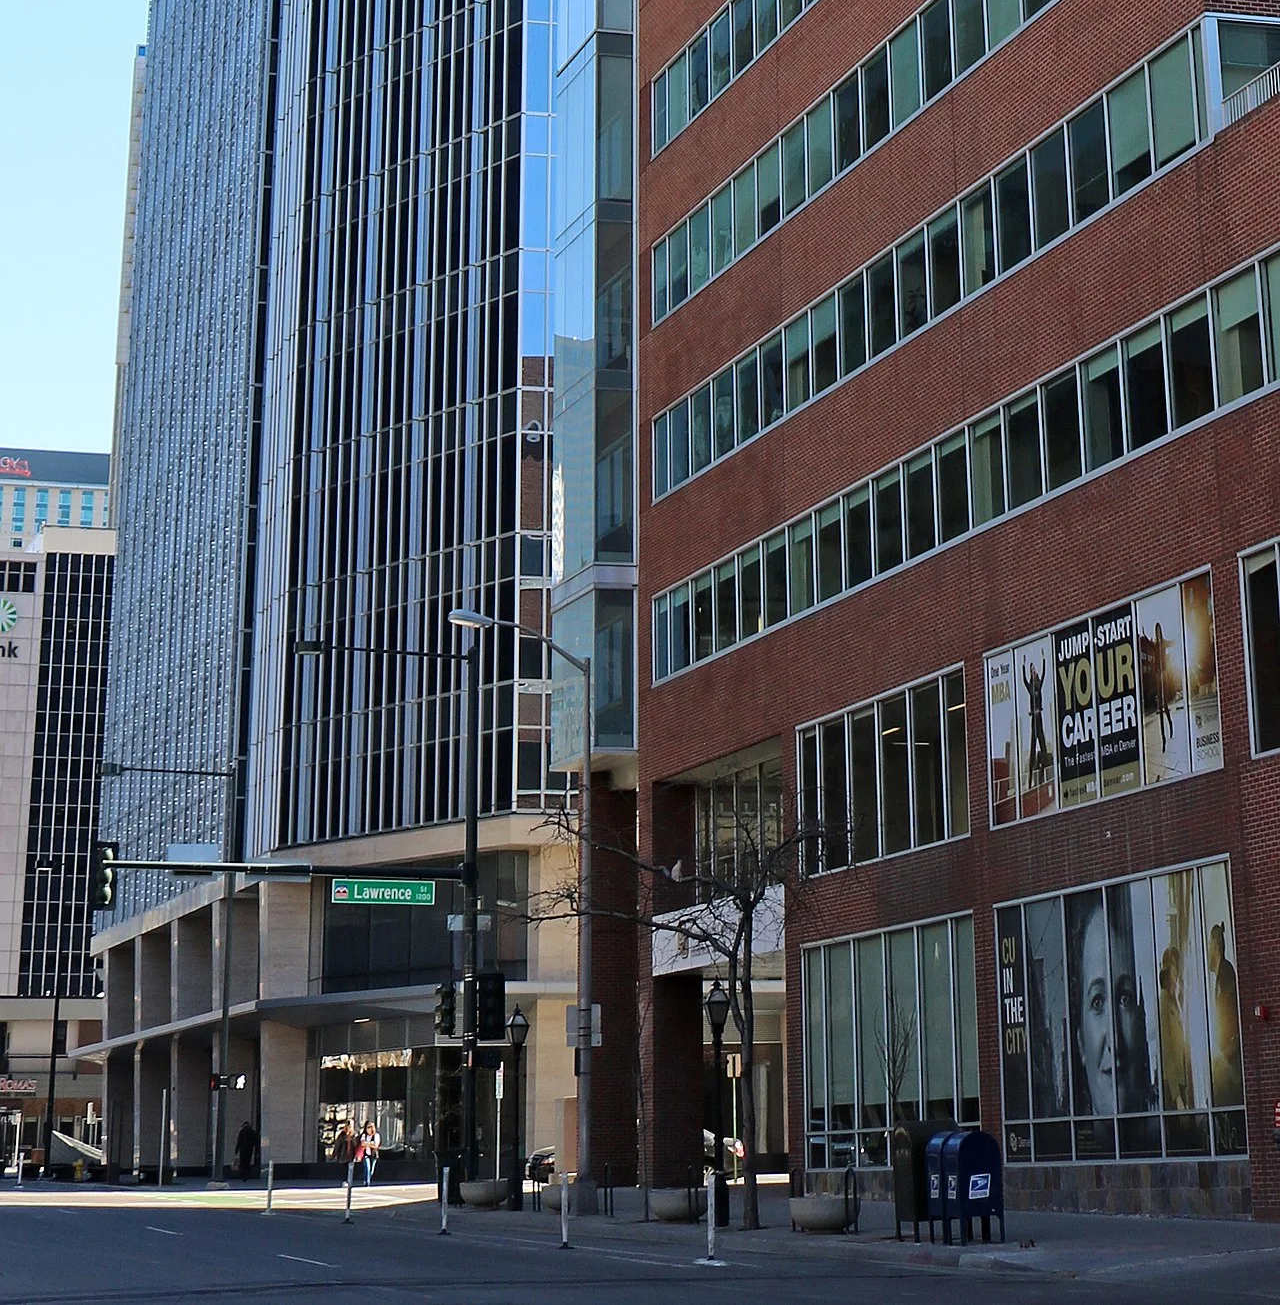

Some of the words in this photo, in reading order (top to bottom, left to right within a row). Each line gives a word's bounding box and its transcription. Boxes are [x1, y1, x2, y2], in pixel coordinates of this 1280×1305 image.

[1058, 642, 1134, 710] YOUR
[991, 680, 1011, 705] MBA
[1062, 695, 1136, 748] CAREER
[1119, 738, 1136, 751] Denver
[354, 884, 412, 900] Lawrence
[1002, 936, 1016, 964] CU
[1003, 967, 1014, 994] IN
[1004, 996, 1025, 1024] THE
[1005, 1027, 1028, 1055] CITY
